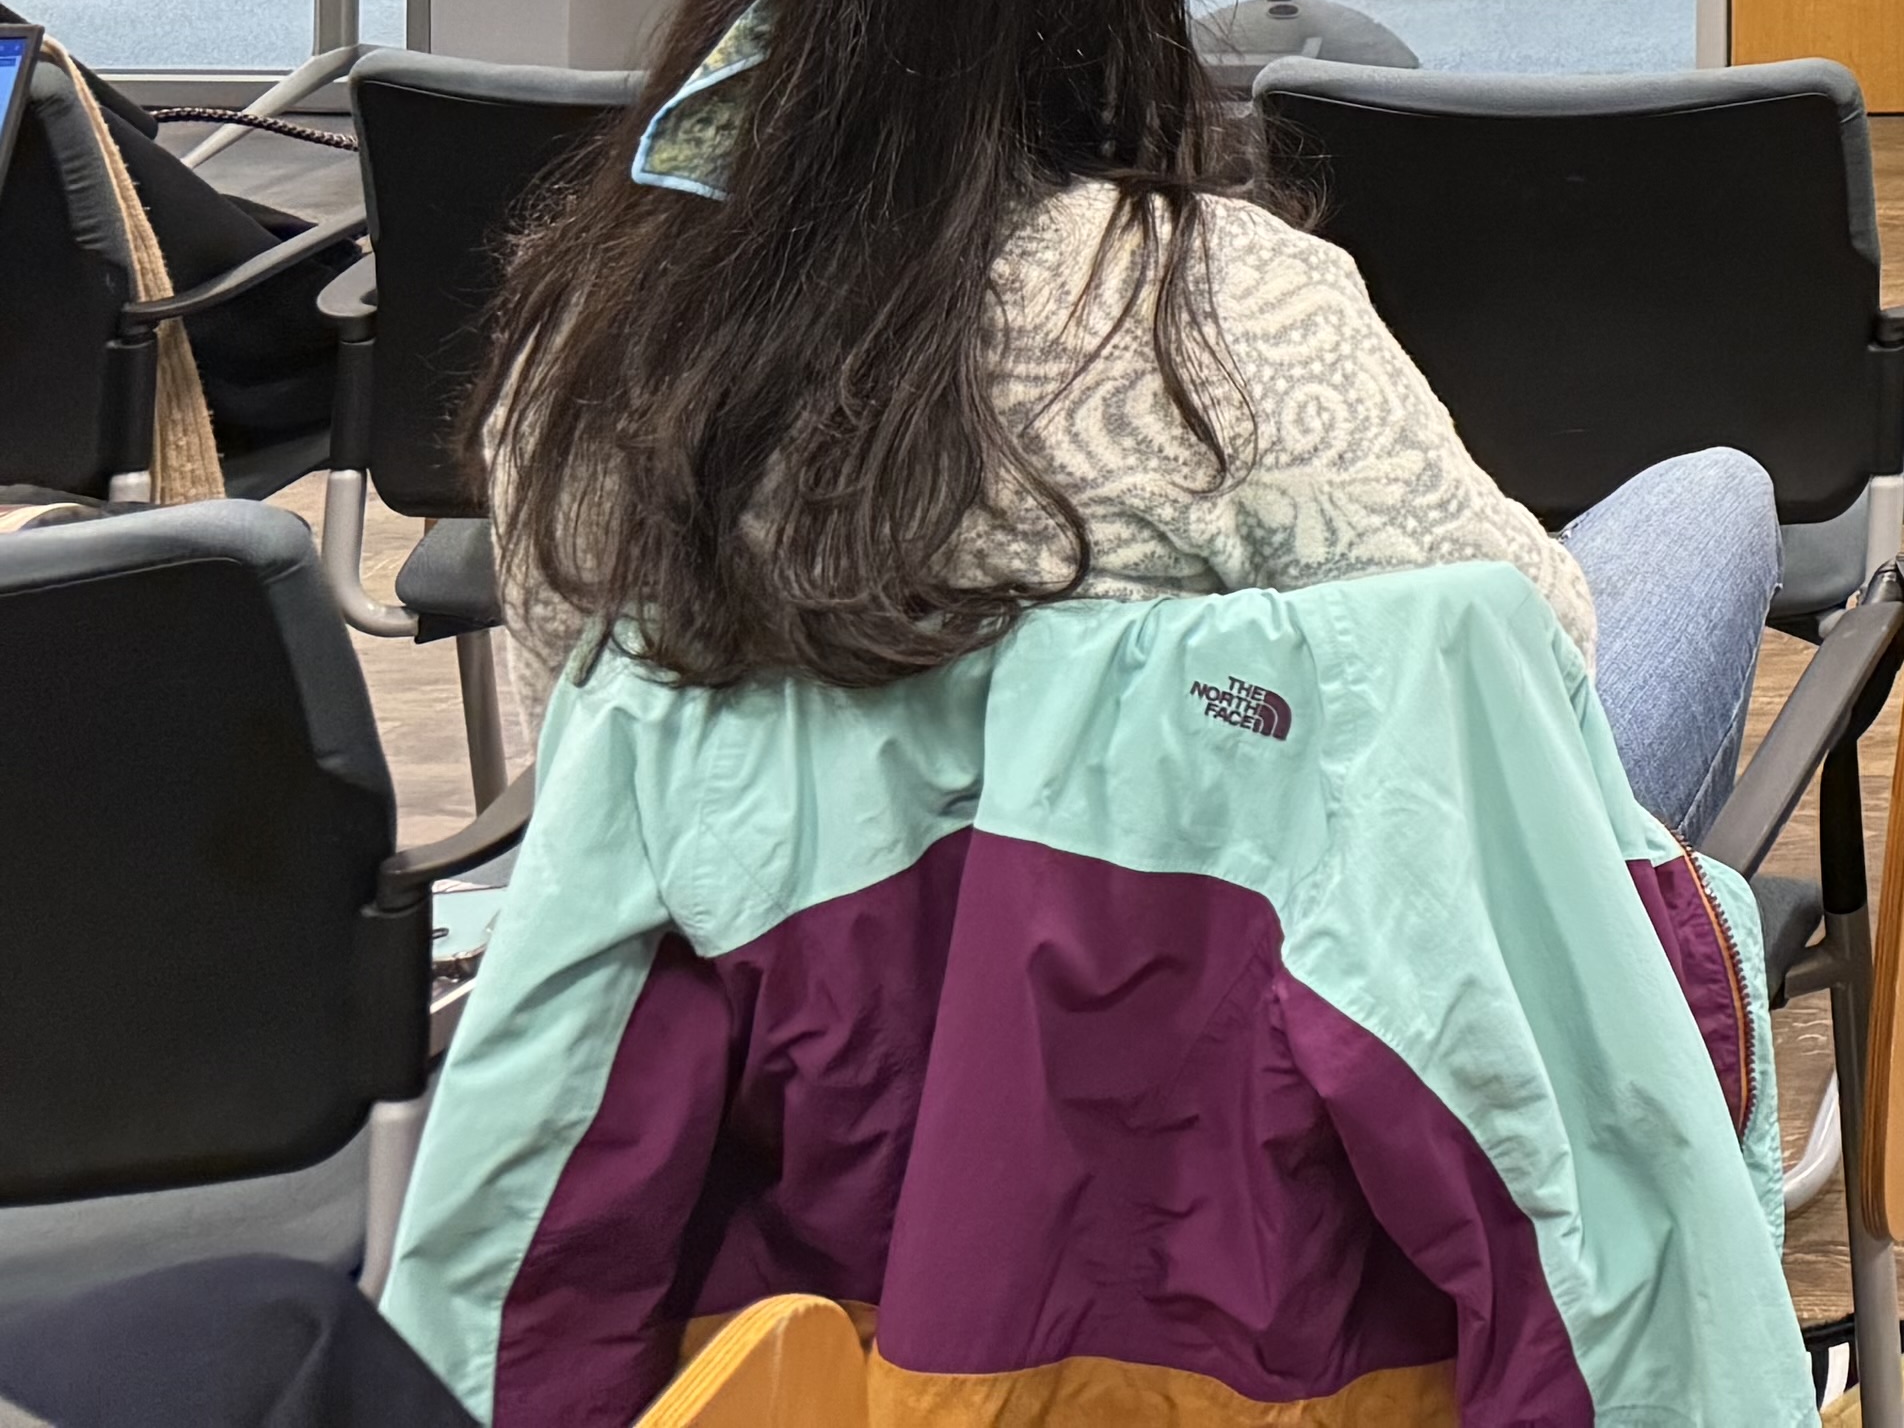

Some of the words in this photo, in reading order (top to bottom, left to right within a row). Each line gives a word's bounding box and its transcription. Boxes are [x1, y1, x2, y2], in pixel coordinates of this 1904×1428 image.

[1190, 680, 1260, 717] NORTH
[1228, 675, 1266, 702] THE
[1204, 702, 1254, 730] FACE
